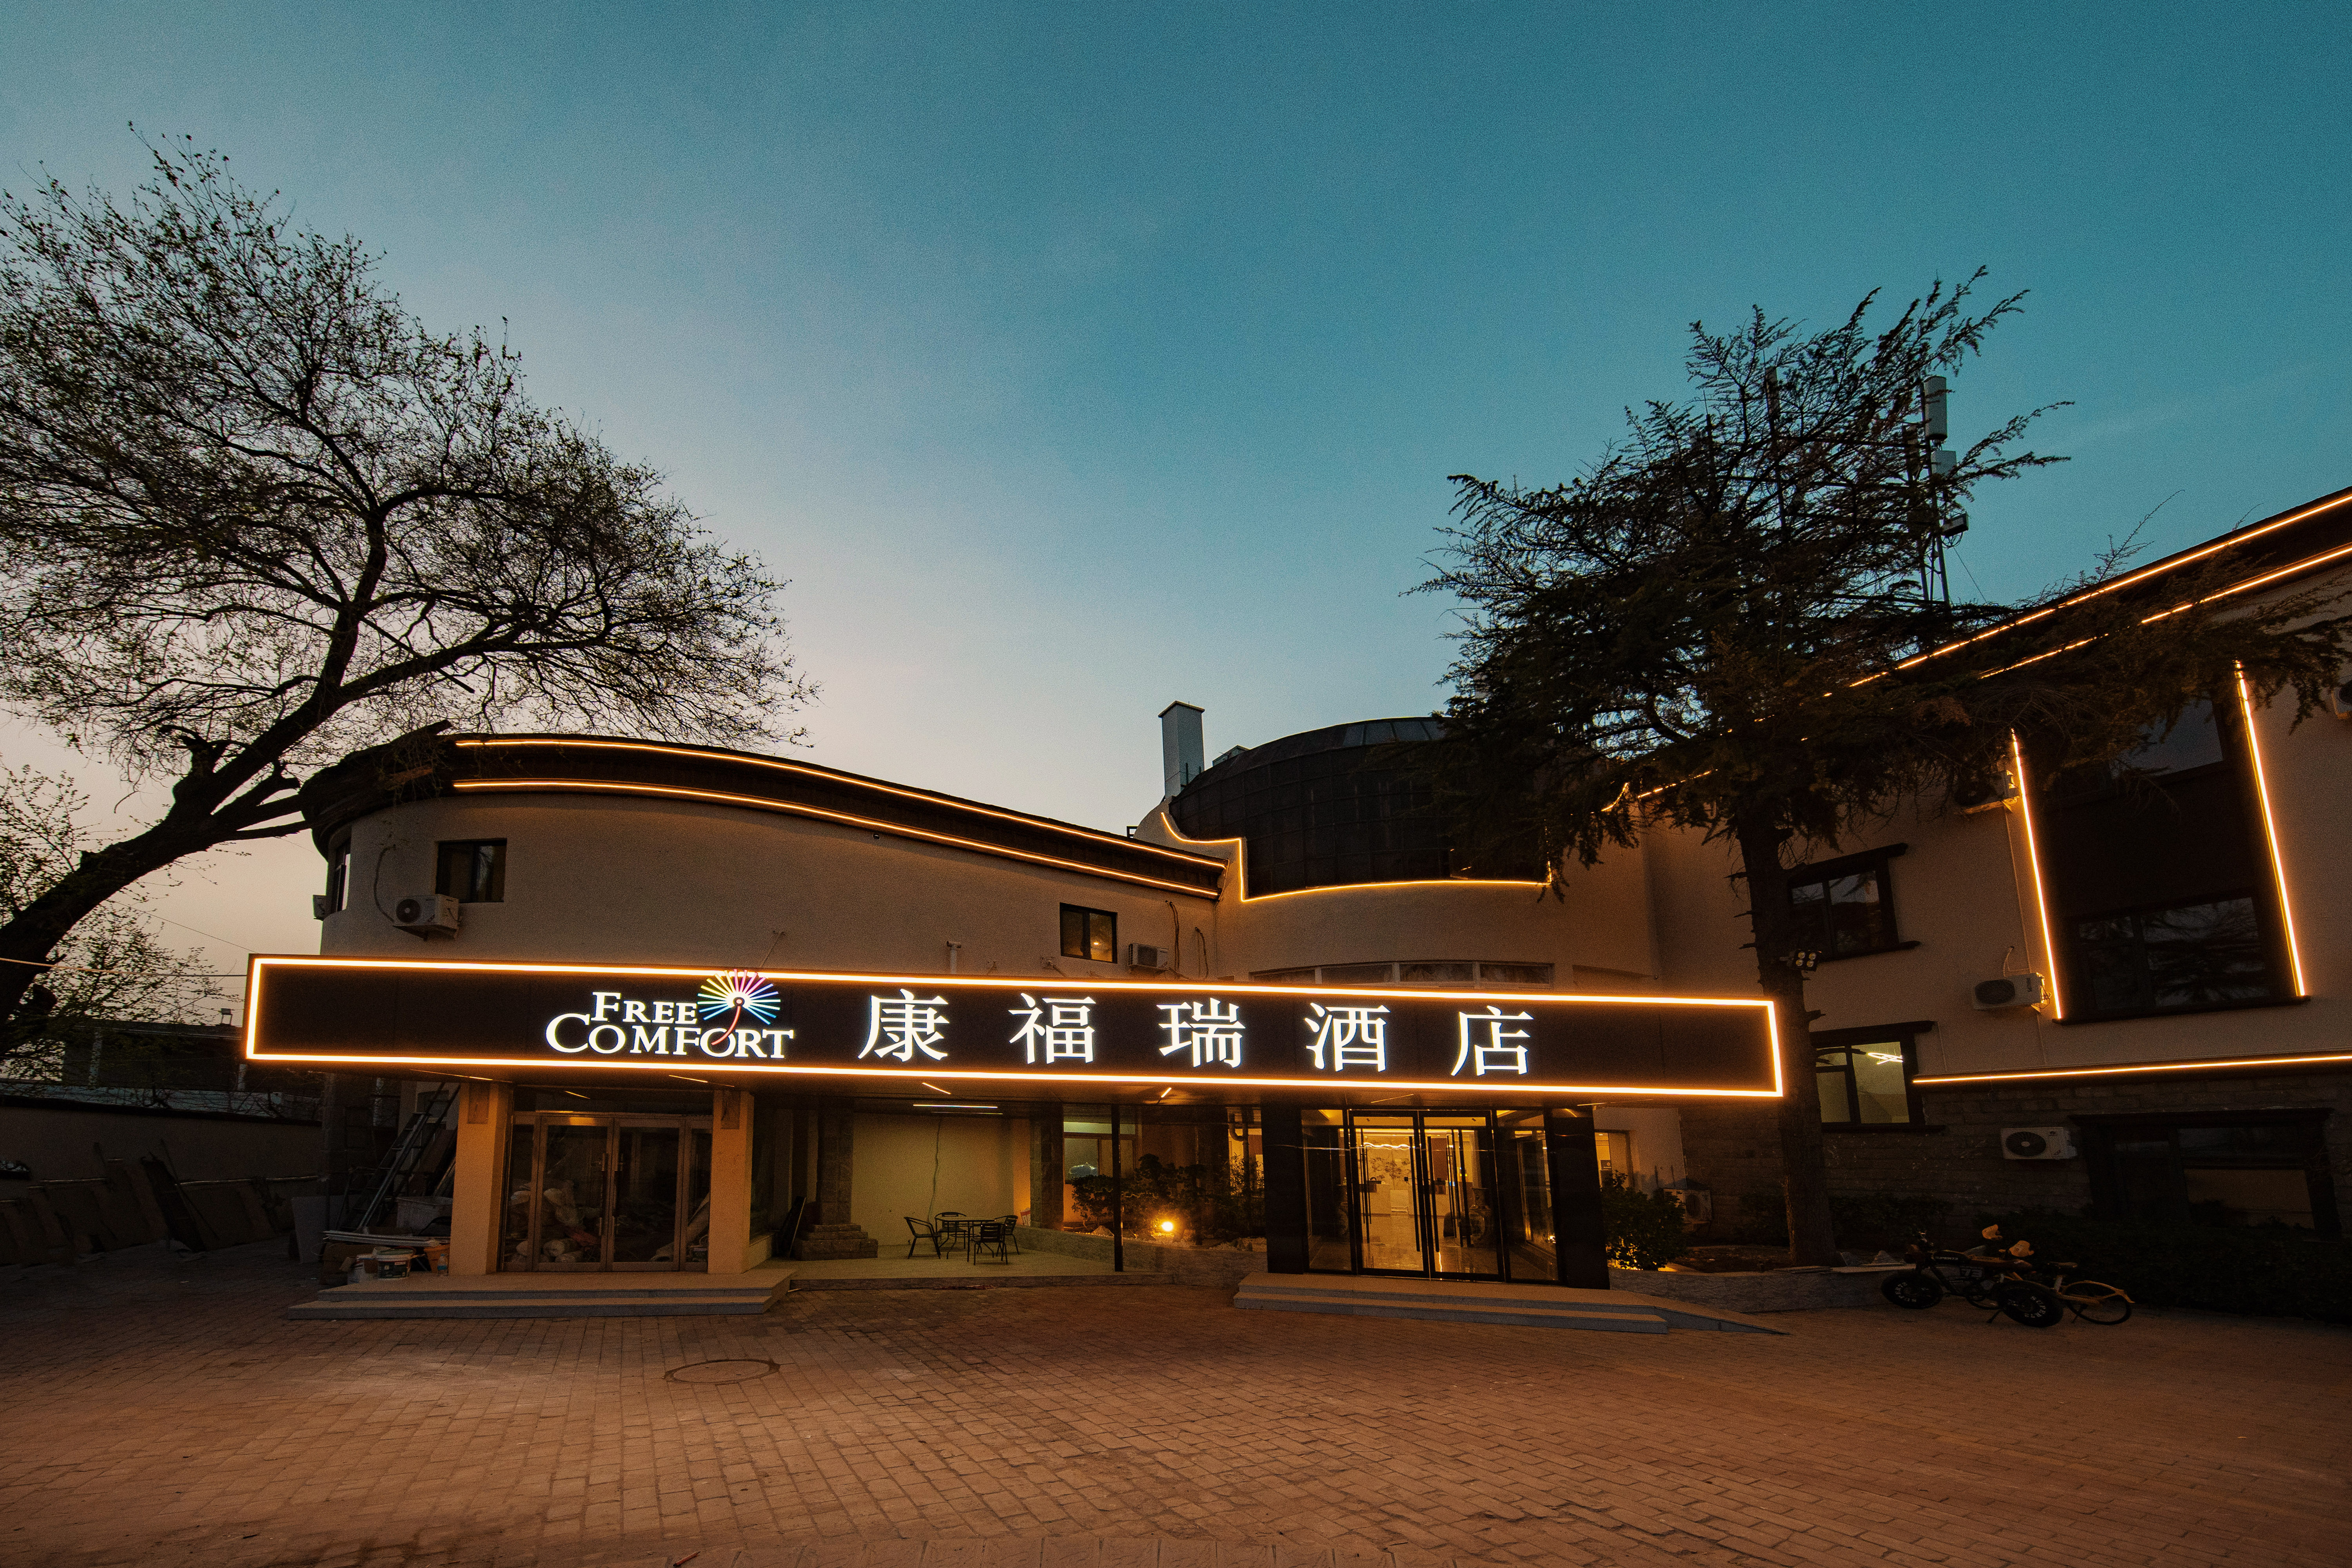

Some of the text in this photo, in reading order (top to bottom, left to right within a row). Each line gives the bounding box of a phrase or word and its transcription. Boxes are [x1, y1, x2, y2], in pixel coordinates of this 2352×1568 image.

[590, 991, 697, 1025] FREE
[545, 1013, 794, 1059] COMFORT
[857, 988, 1534, 1076] 康福瑞酒店
[1961, 1268, 1982, 1278] 73
